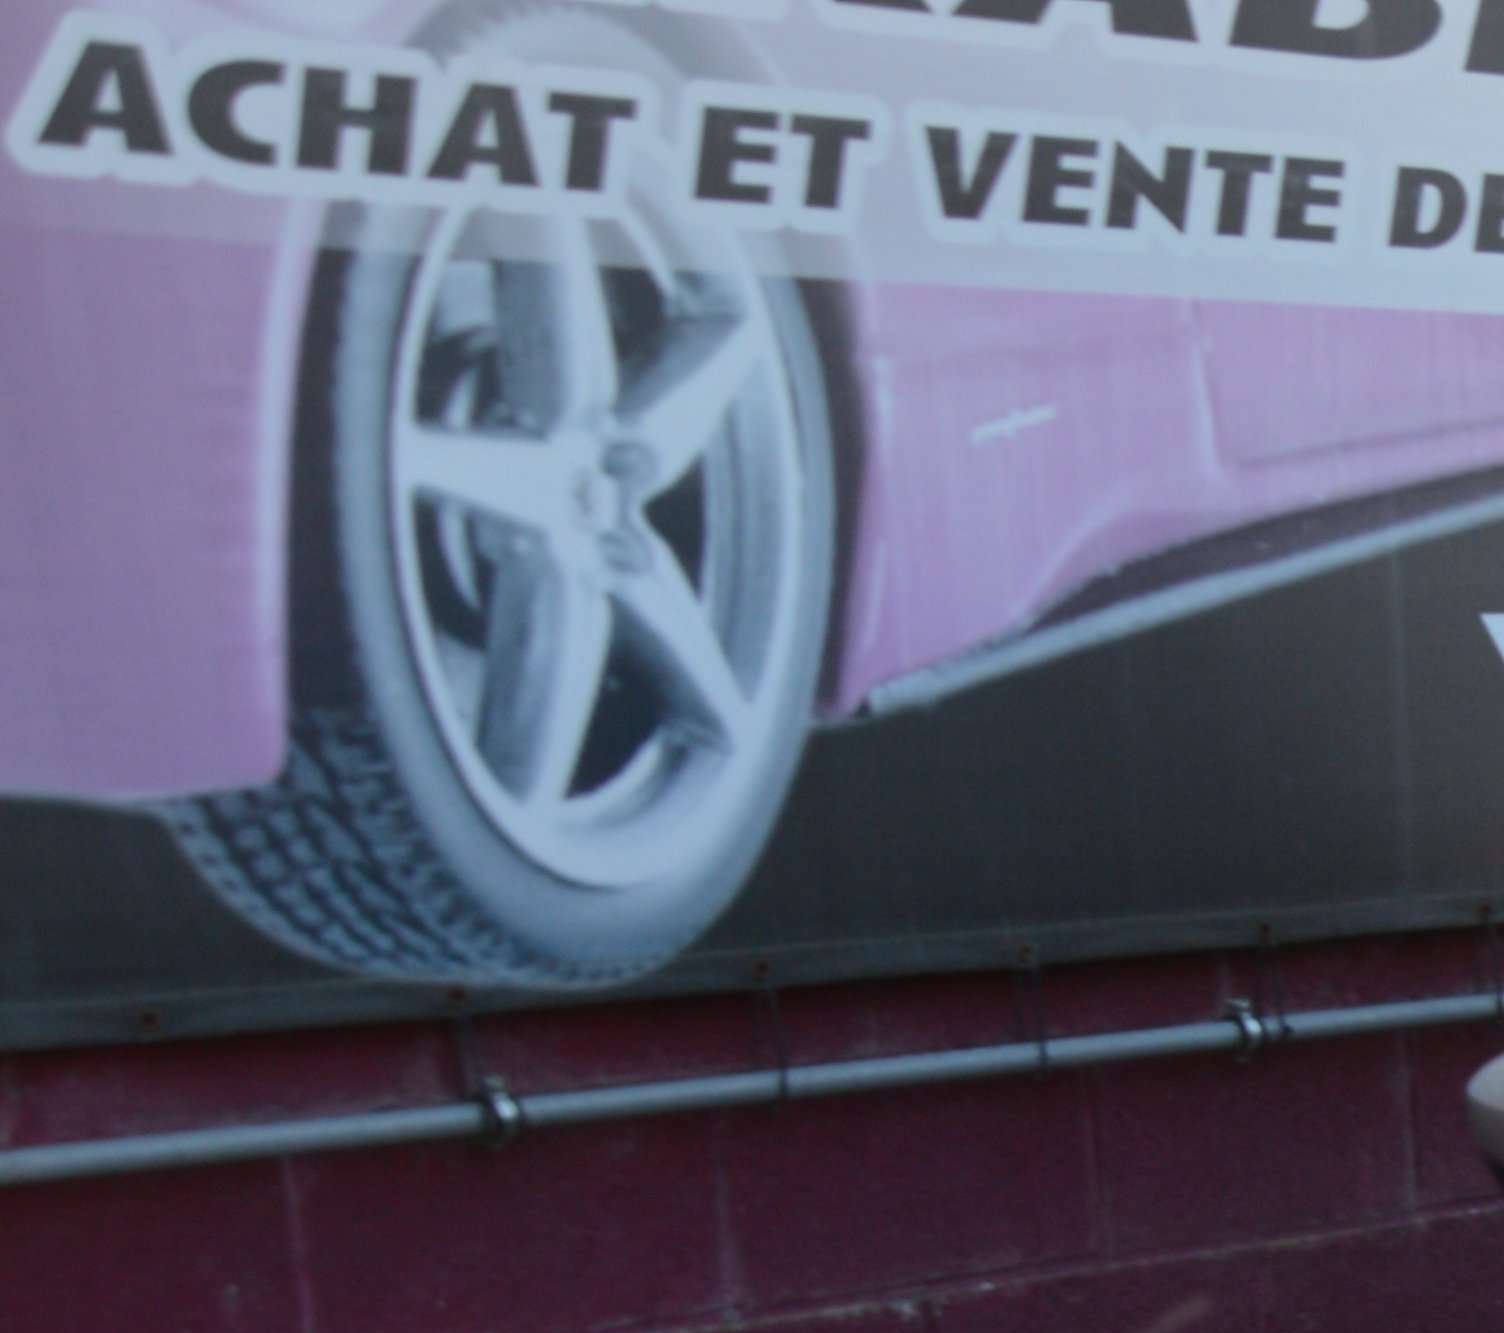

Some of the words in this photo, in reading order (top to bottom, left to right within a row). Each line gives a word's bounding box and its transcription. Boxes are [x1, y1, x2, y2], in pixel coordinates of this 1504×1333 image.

[36, 40, 638, 192] ACHAT
[694, 106, 872, 209] ET
[924, 126, 1345, 243] VENTE
